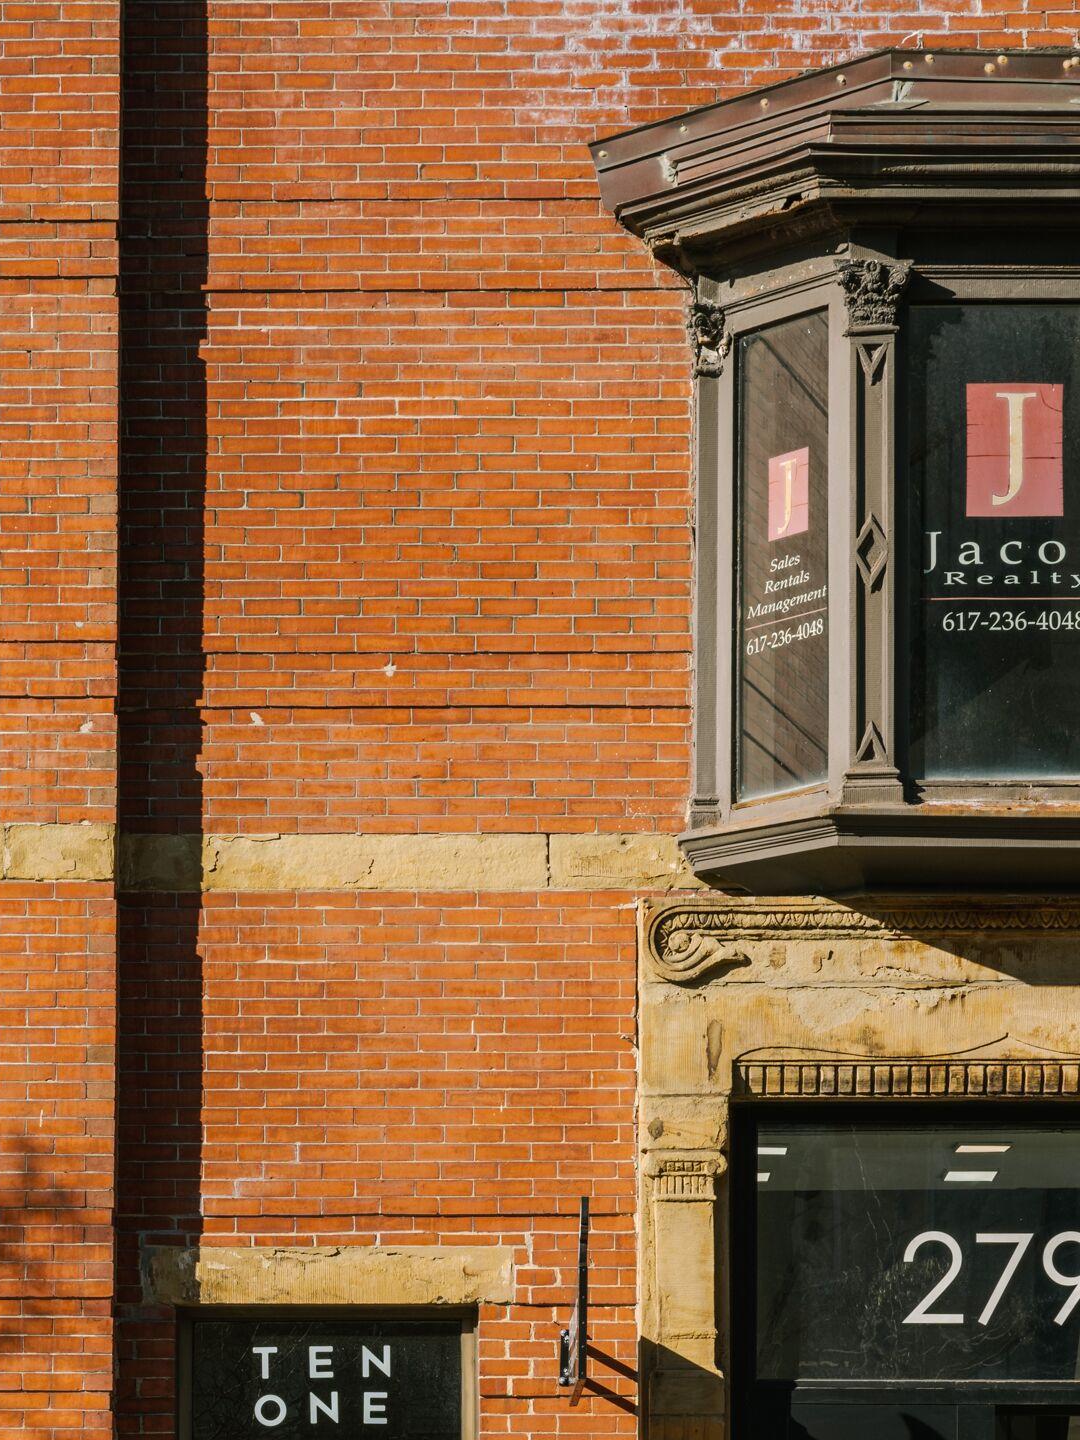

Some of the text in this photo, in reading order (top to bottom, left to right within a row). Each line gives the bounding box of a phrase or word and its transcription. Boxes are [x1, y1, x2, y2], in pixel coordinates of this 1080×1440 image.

[991, 392, 1037, 506] J
[777, 458, 797, 534] J
[769, 554, 801, 573] Sales
[764, 570, 810, 595] Rentals
[746, 584, 828, 620] Management
[746, 618, 824, 656] 617-236-4048
[901, 1230, 1080, 1326] 279
[252, 1345, 391, 1380] TEN
[254, 1391, 388, 1427] ONE
